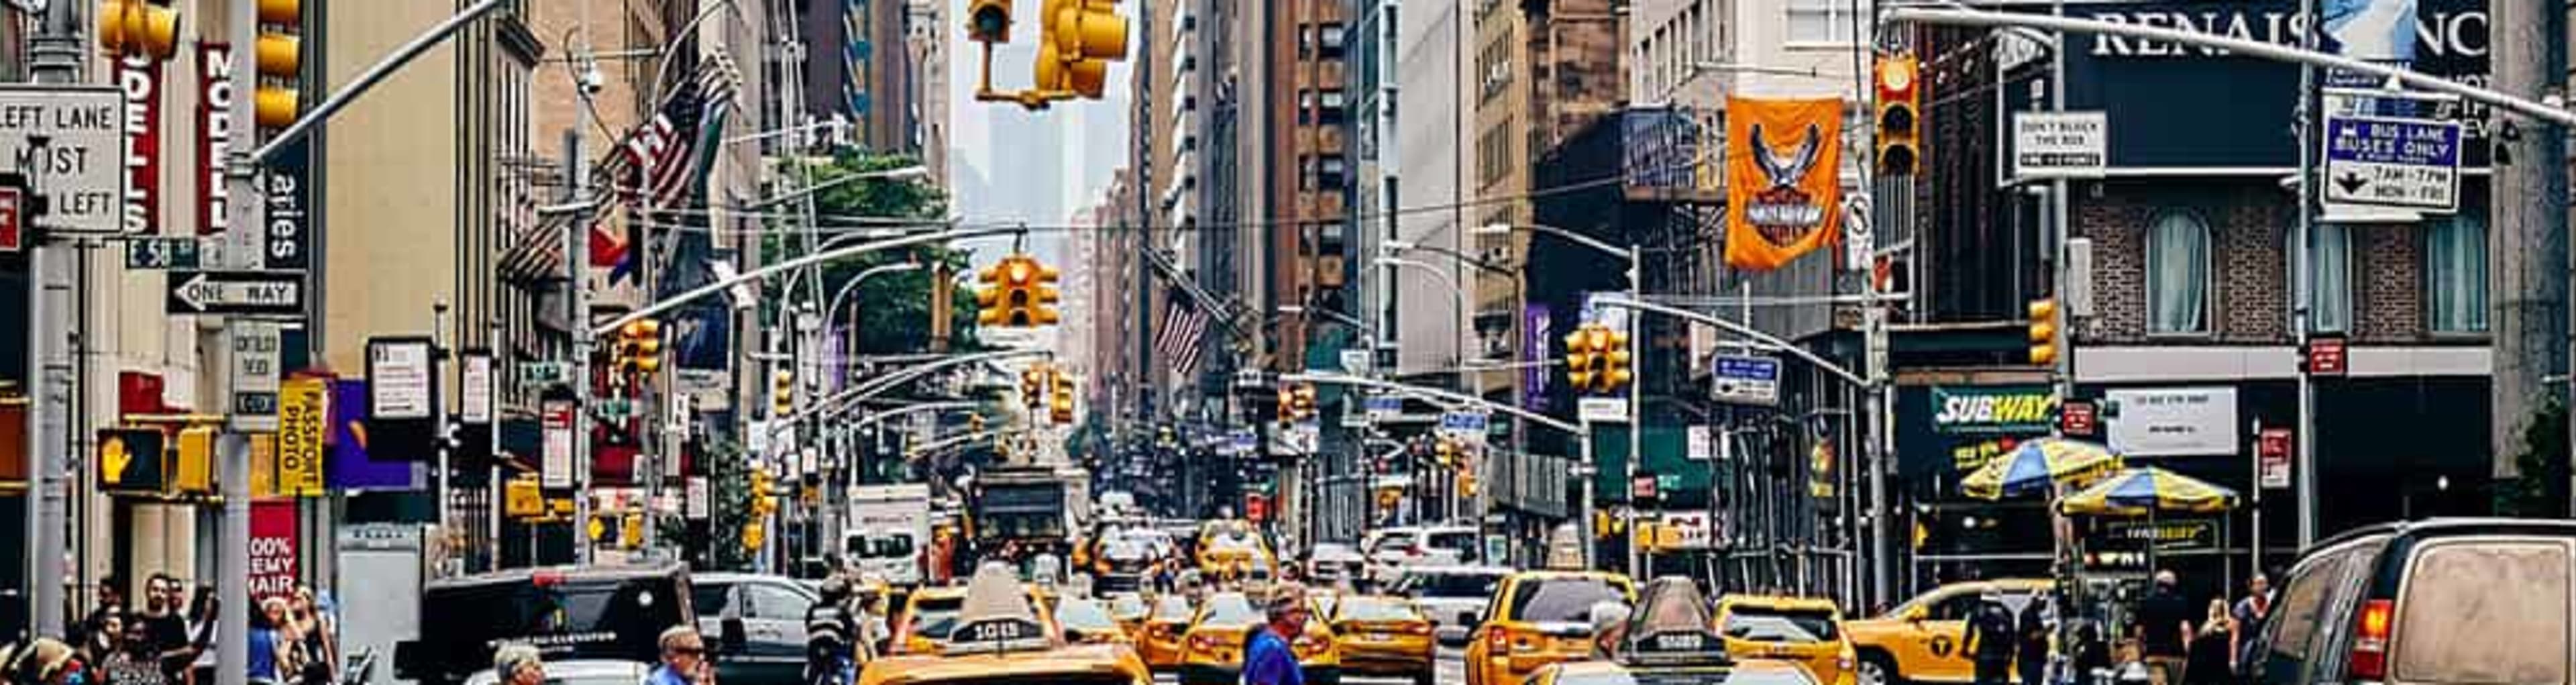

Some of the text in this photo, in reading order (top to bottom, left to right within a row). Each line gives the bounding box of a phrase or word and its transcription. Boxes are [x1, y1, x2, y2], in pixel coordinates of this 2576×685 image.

[2092, 11, 2487, 56] RENAISNC
[56, 107, 112, 129] LANE
[2371, 123, 2445, 142] BUS LANE
[2404, 141, 2449, 157] ONLY
[60, 192, 111, 215] LEFT
[188, 283, 287, 301] ONE WAY
[1936, 394, 2051, 423] SUBWAY
[285, 405, 301, 471] PHOTO
[250, 537, 290, 556] 00%
[252, 558, 294, 574] EMY
[1936, 639, 1947, 655] T
